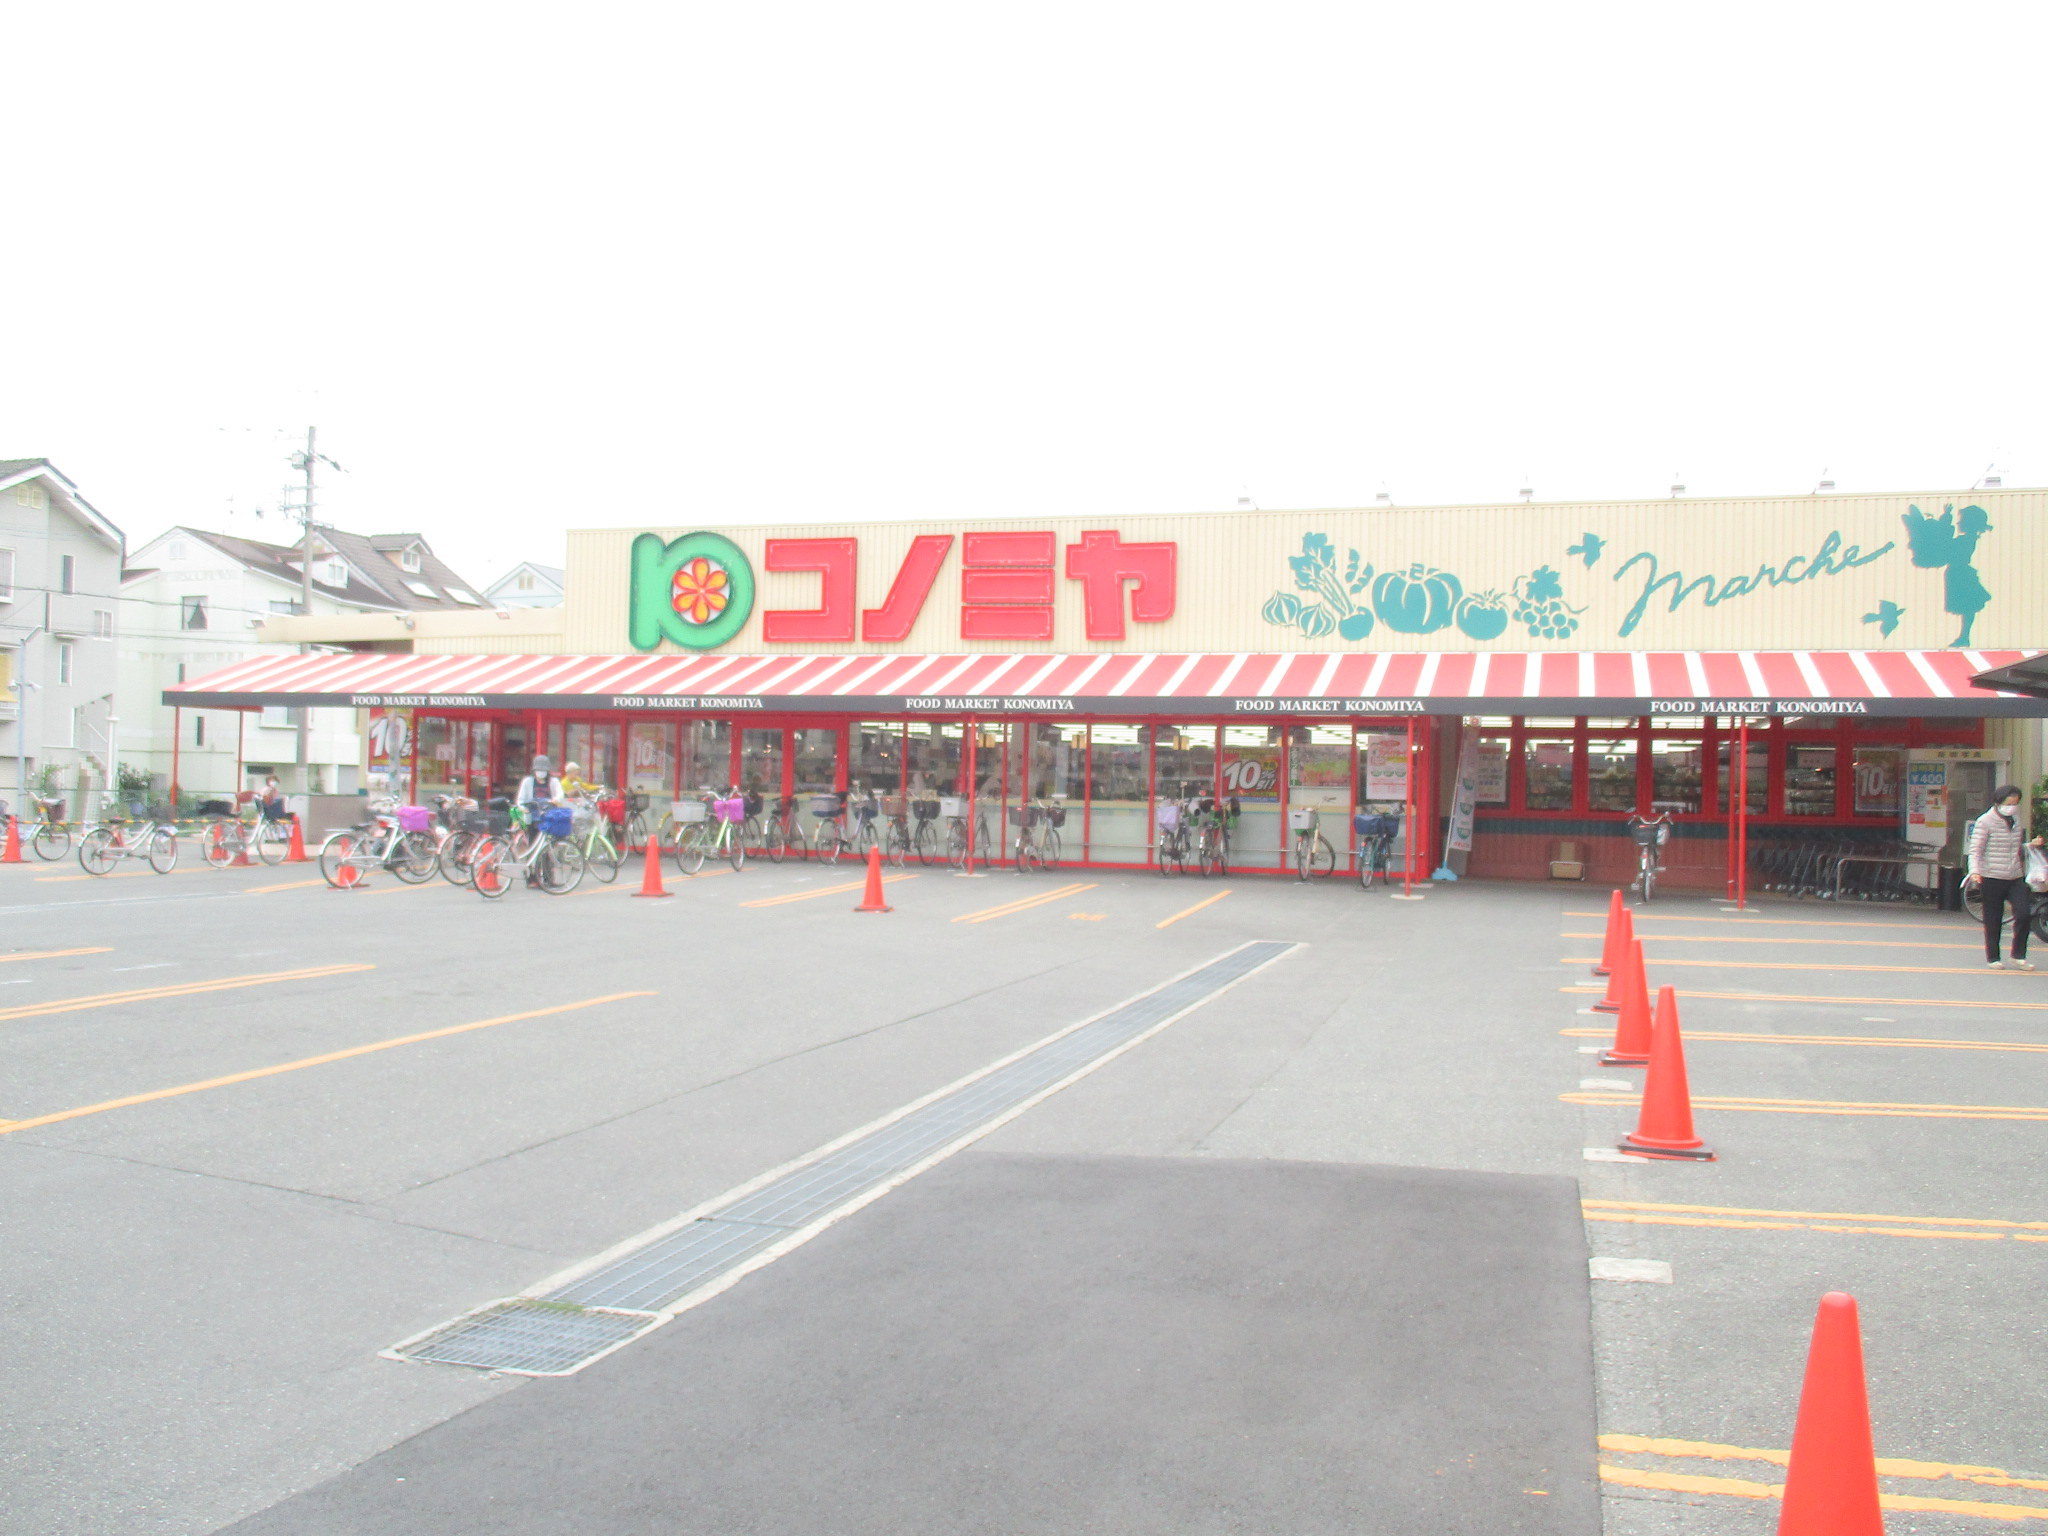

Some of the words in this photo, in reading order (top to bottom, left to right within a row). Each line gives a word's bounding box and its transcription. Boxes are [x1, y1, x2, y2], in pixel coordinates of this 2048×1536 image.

[763, 529, 1178, 643] コノミヤ
[352, 695, 381, 706] FOOD
[383, 696, 427, 706] MARKET
[429, 696, 487, 706] KONOMIYA
[613, 696, 645, 707] FOOD
[648, 697, 697, 708] MARKET
[701, 698, 764, 708] KONOMIYA
[906, 698, 941, 709] FOOD
[945, 698, 999, 709] MARKET
[1003, 699, 1075, 710] KONOMIYA
[1235, 700, 1275, 711] FOOD
[1279, 700, 1340, 712] MARKET
[1345, 700, 1425, 712] KONOMIYA
[1650, 700, 1696, 713] FOOD
[1701, 700, 1771, 713] MARKET
[1775, 701, 1868, 713] KONOMIYA
